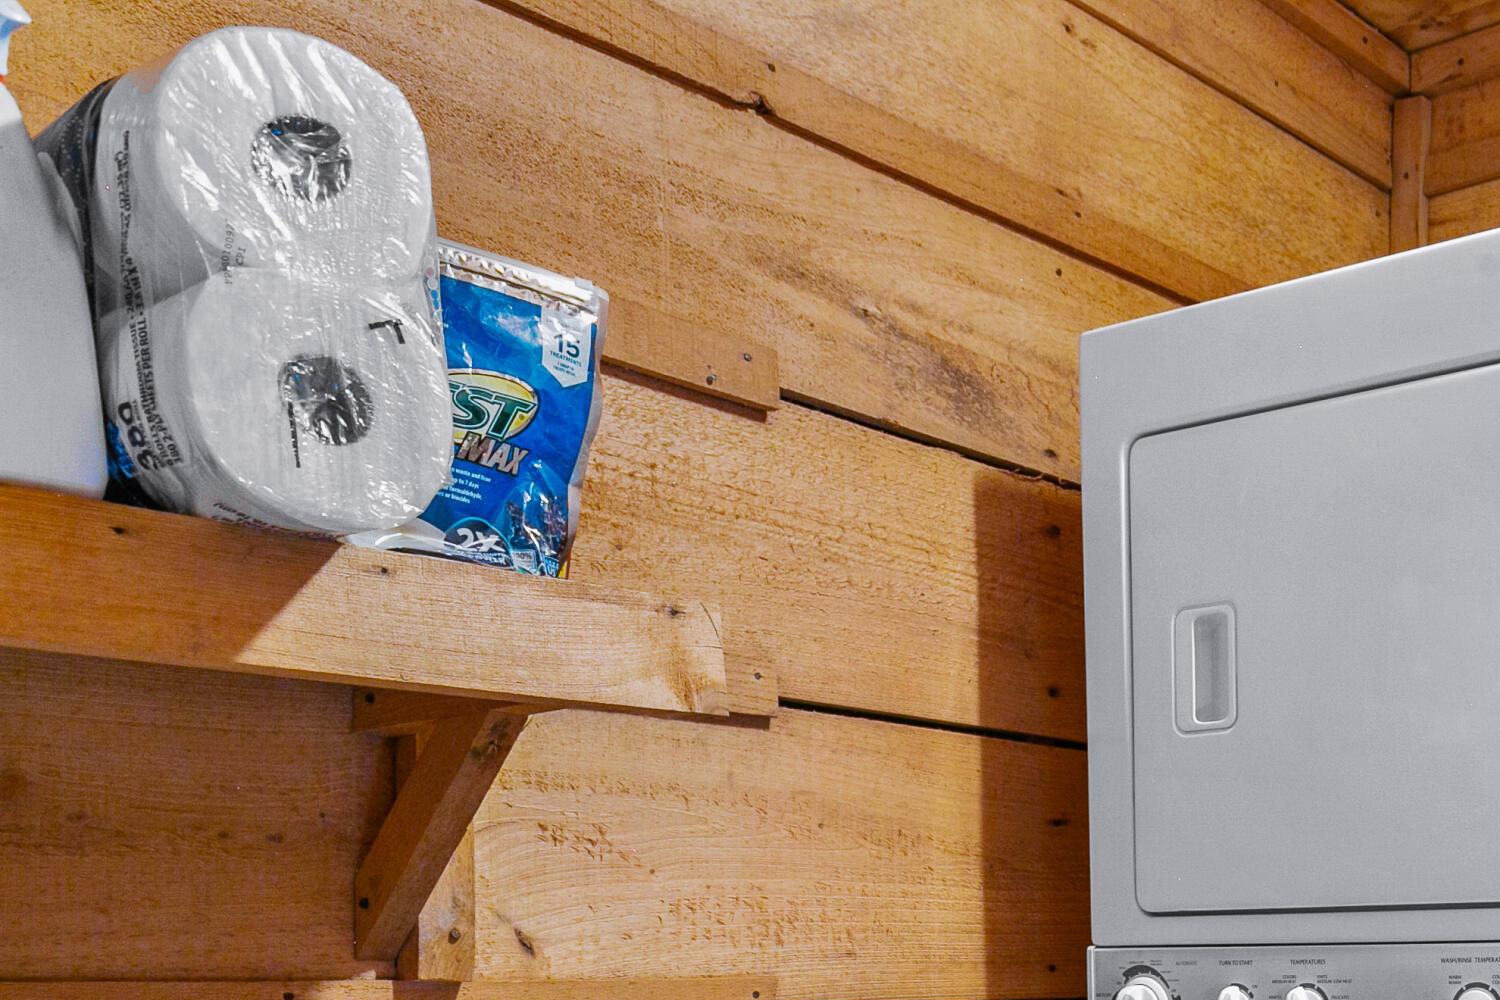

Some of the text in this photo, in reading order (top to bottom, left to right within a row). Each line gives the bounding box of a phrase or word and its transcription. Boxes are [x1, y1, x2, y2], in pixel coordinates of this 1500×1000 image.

[136, 317, 150, 349] ROLL
[554, 333, 580, 358] 15
[457, 431, 529, 476] MAX
